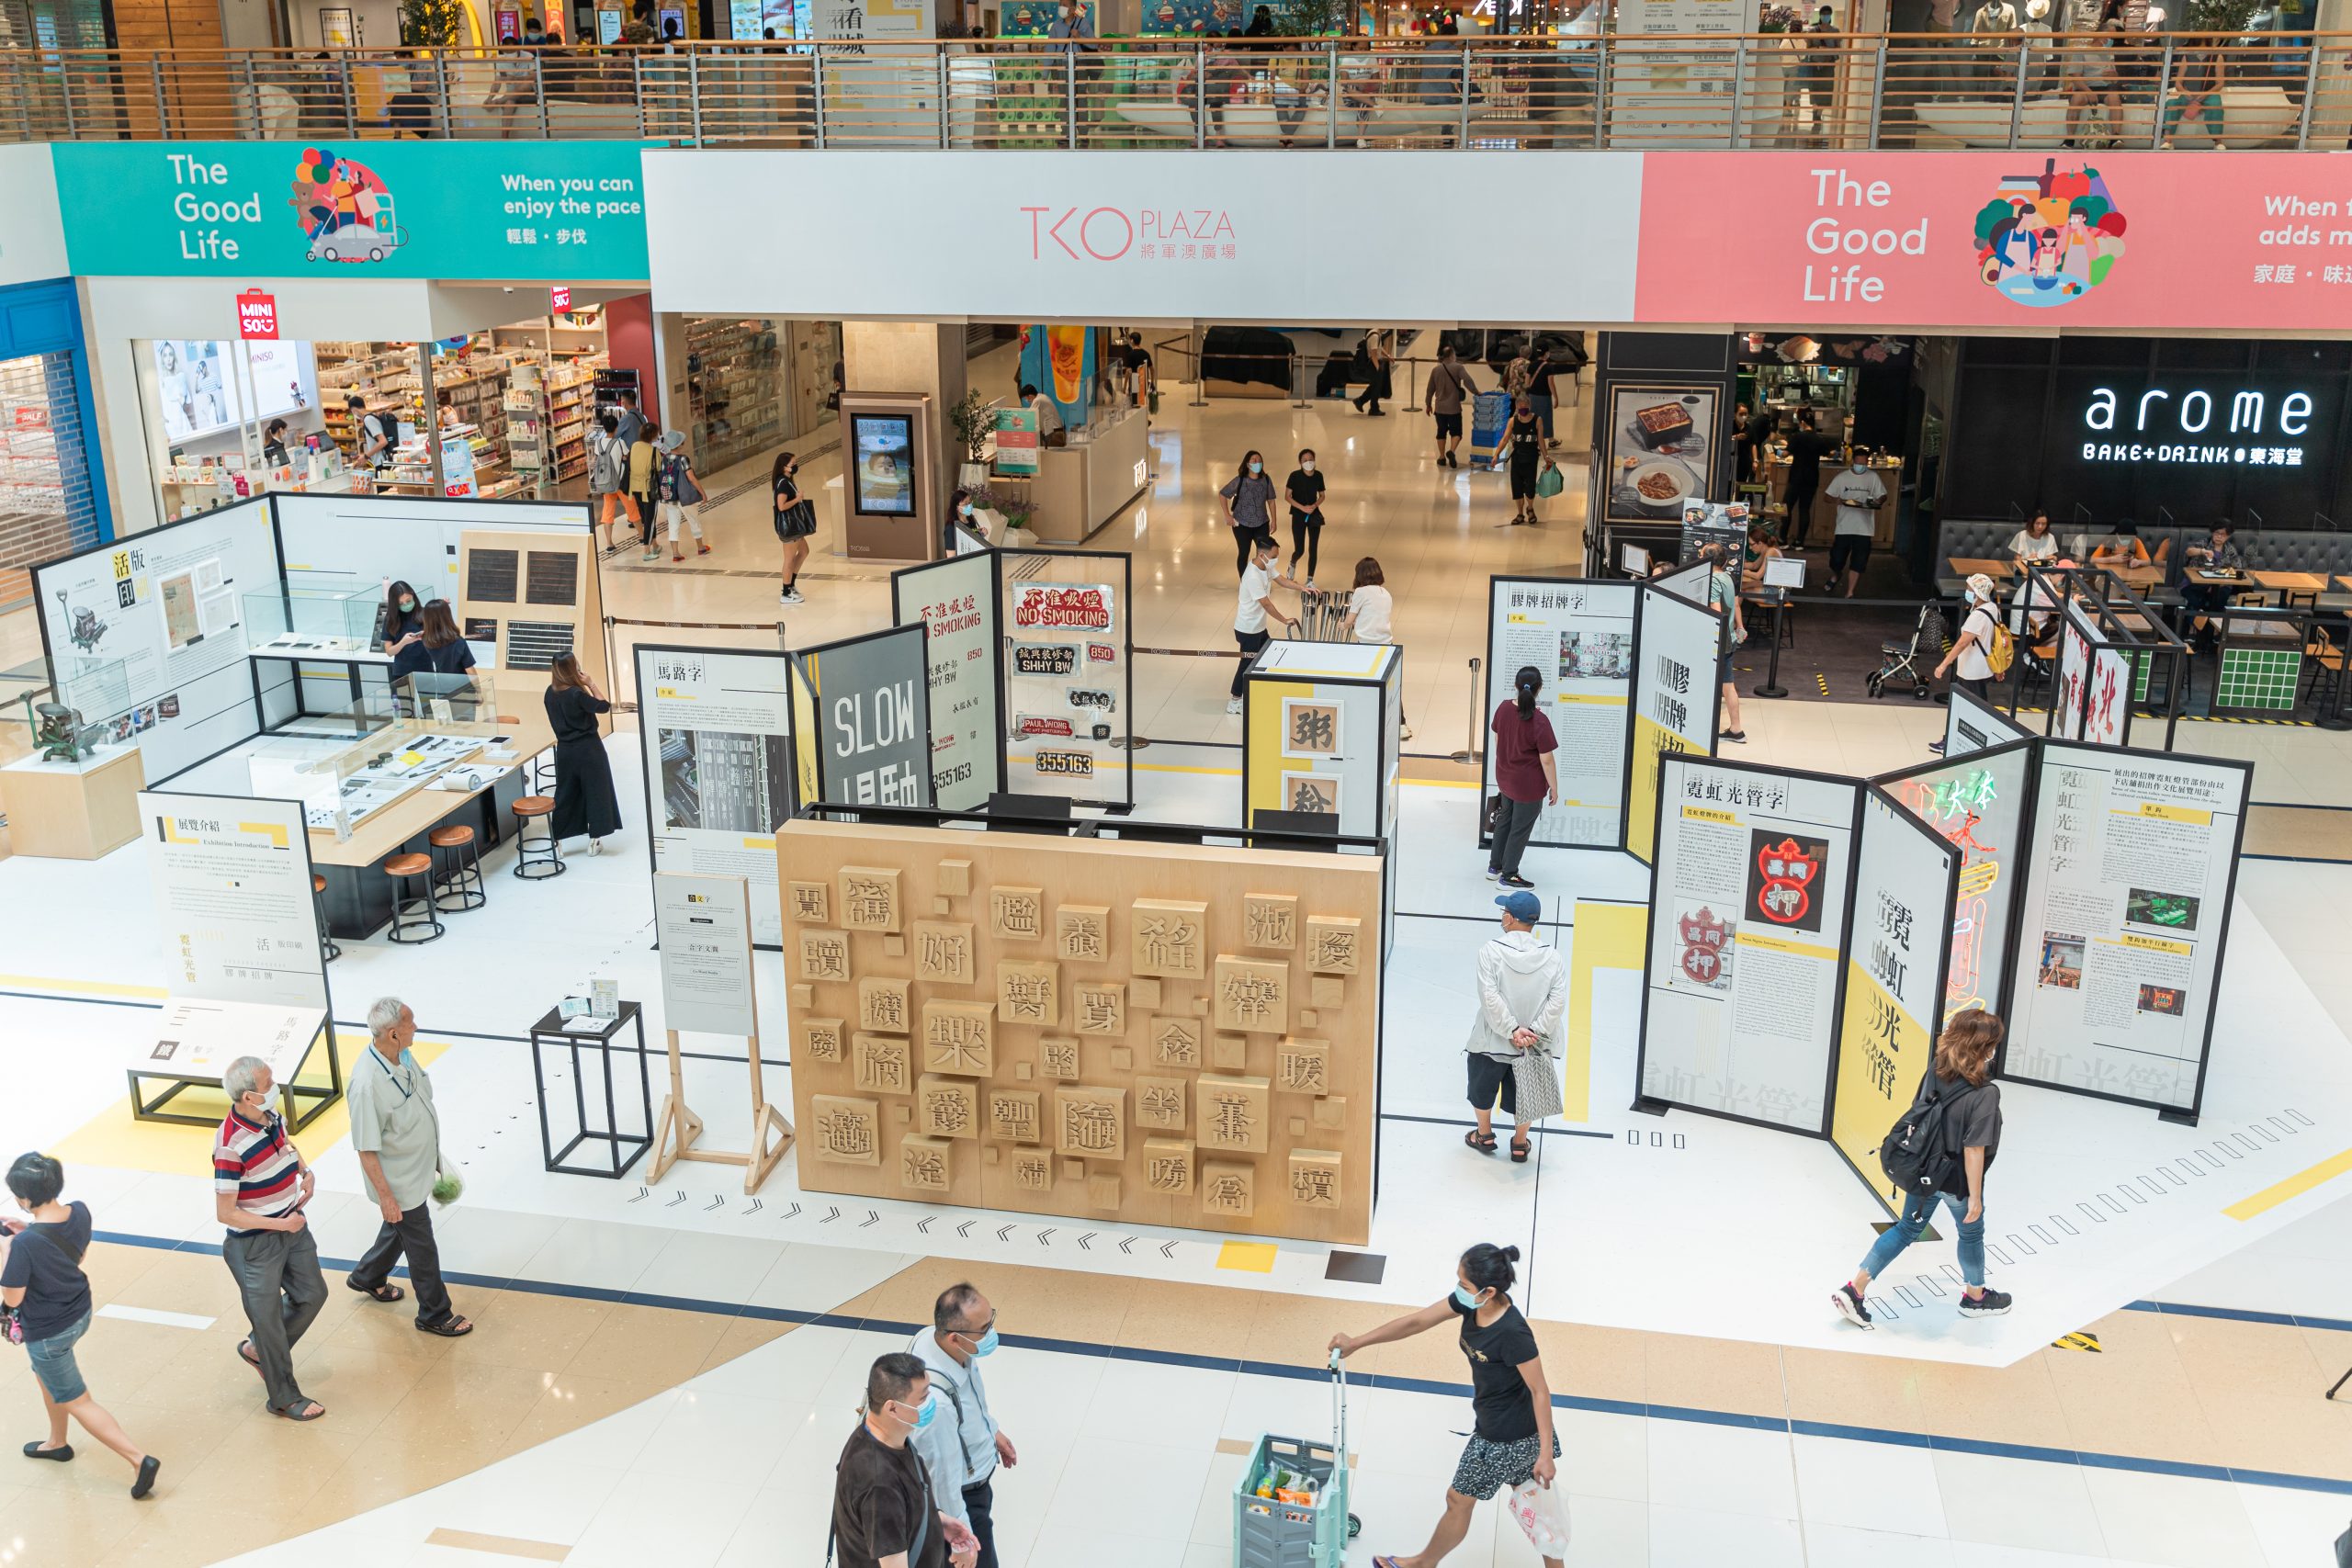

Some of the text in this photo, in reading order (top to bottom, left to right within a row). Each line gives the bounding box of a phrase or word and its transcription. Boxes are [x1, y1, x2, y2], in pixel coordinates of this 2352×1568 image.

[167, 154, 228, 184] The
[501, 175, 633, 196] When you can
[1811, 169, 1891, 207] The
[175, 193, 262, 223] Good
[504, 197, 640, 219] enjoy the pace
[2265, 196, 2338, 217] When
[1020, 207, 1236, 261] TKO PLAZA
[1806, 218, 1928, 255] Good
[2259, 225, 2320, 245] adds
[180, 231, 240, 260] Life
[1140, 243, 1236, 259] 將軍澳廣場
[1804, 265, 1885, 302] Life
[241, 303, 273, 317] MINI
[2086, 388, 2312, 435] arome
[2083, 443, 2303, 466] BAKE+DRINK 東海堂
[1024, 590, 1100, 609] 不准吸煙
[1018, 607, 1107, 626] NO SMOKING
[1091, 647, 1111, 659] 850
[658, 663, 702, 682] 馬路字
[1023, 660, 1070, 672] SHHY BW
[834, 680, 915, 757] SLOW
[1036, 752, 1092, 773] 355163
[1686, 777, 1784, 810] 霓虹光管字
[178, 818, 220, 832] 展覽介紹
